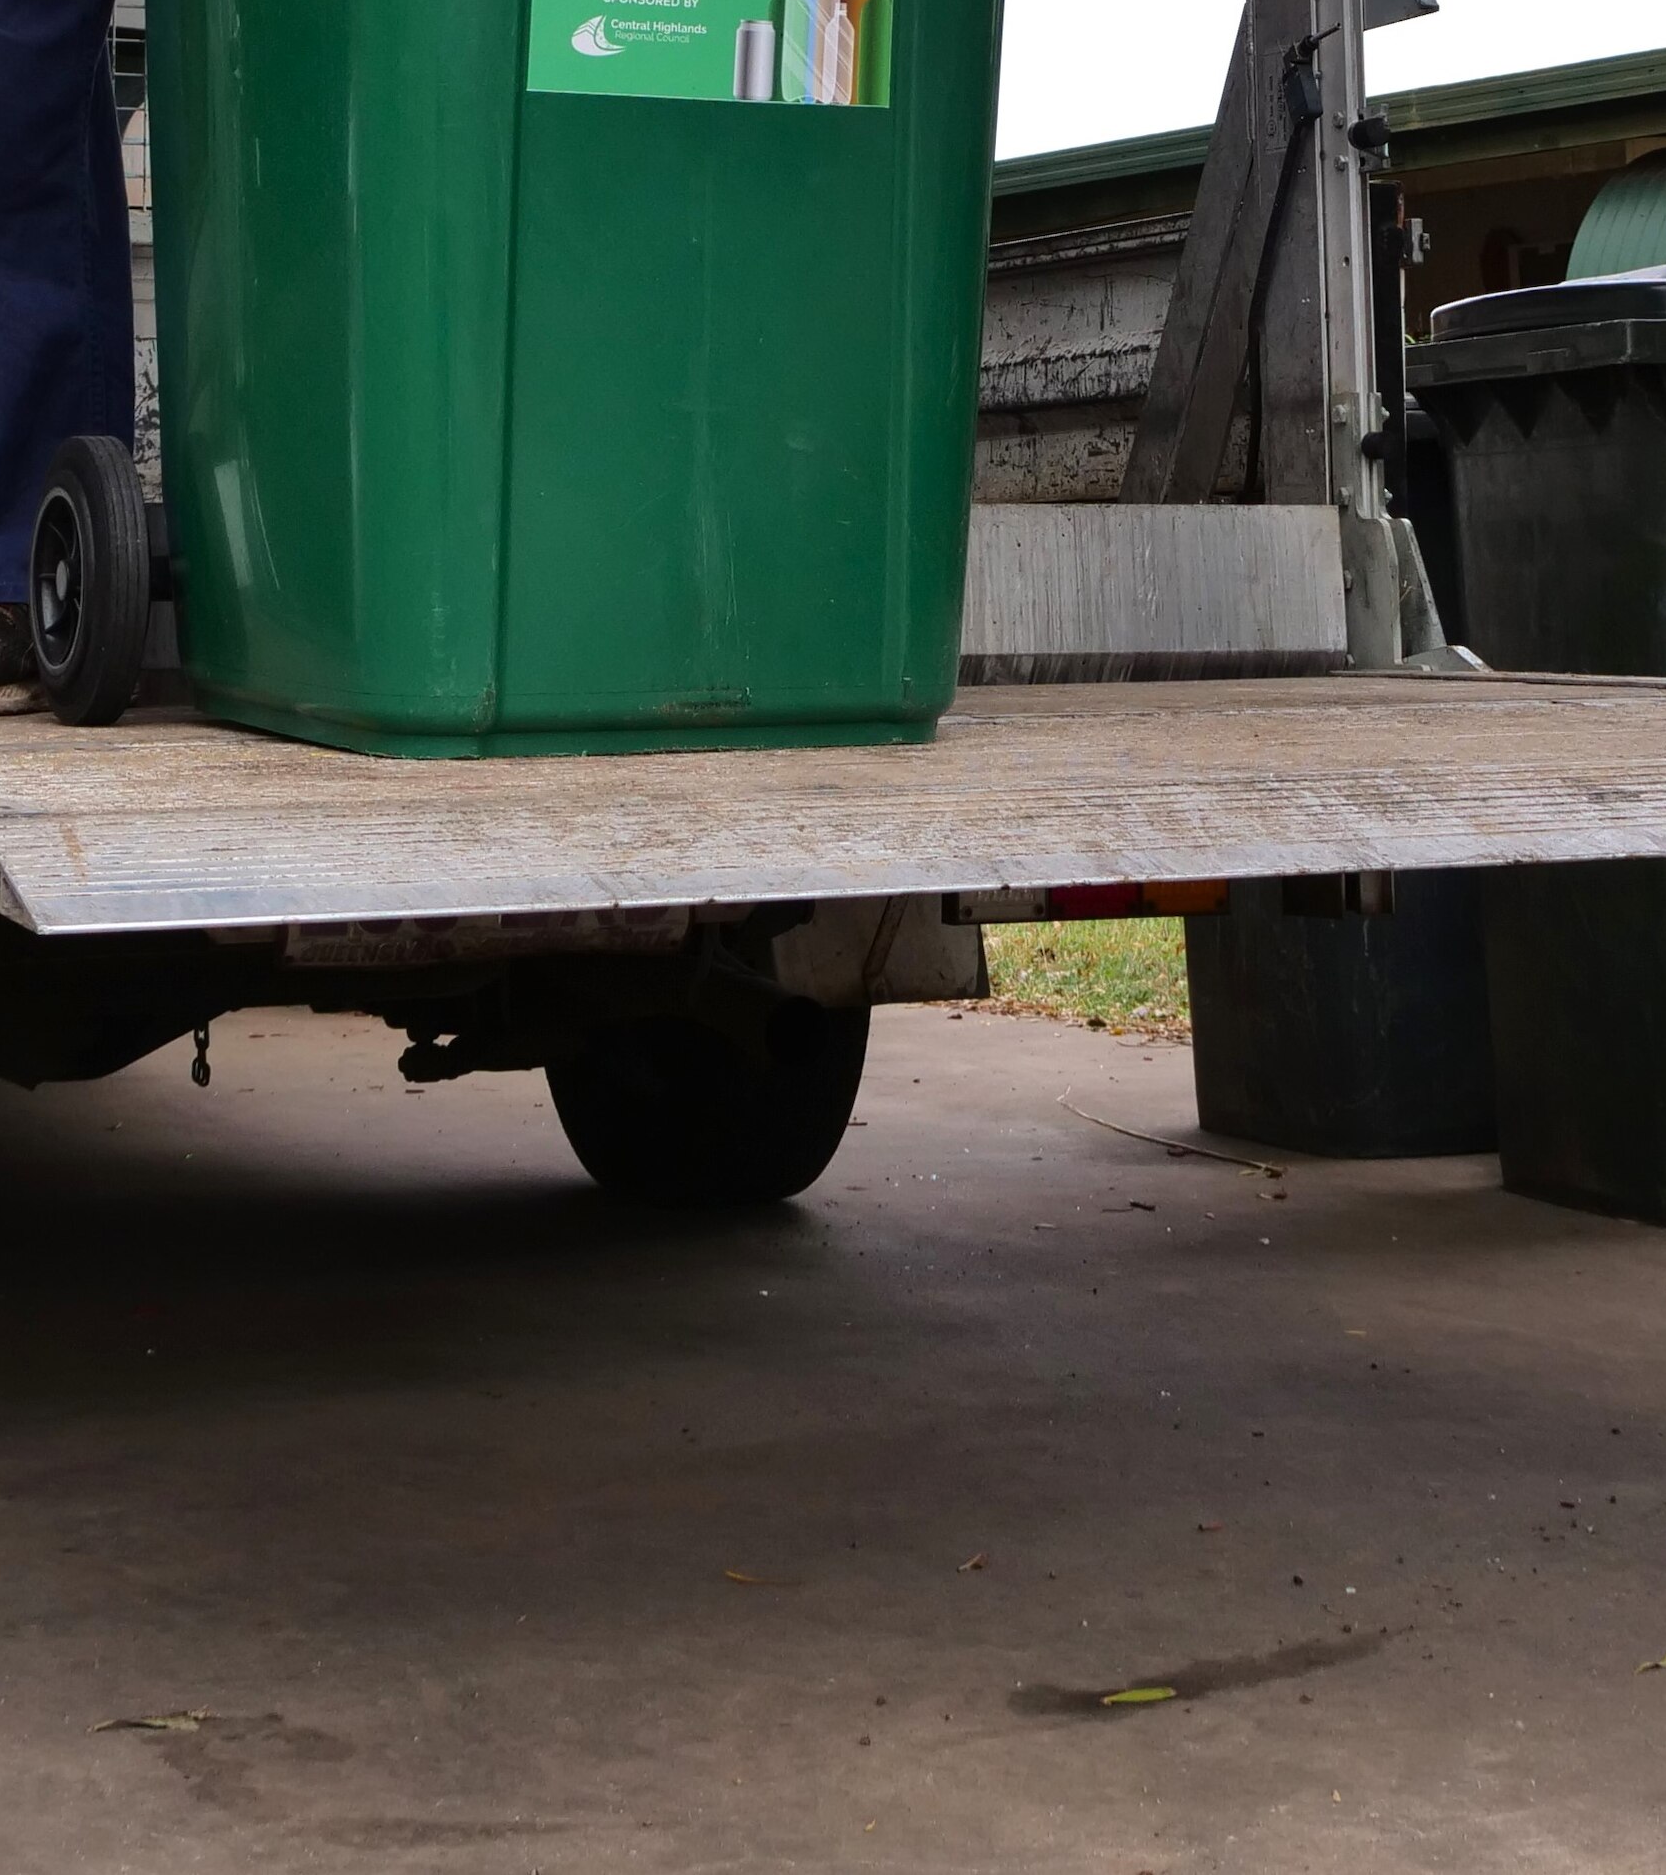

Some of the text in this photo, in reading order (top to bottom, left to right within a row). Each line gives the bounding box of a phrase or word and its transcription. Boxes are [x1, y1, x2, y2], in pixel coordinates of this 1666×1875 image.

[611, 19, 707, 34] Central Highlands
[614, 30, 690, 43] Regional Council
